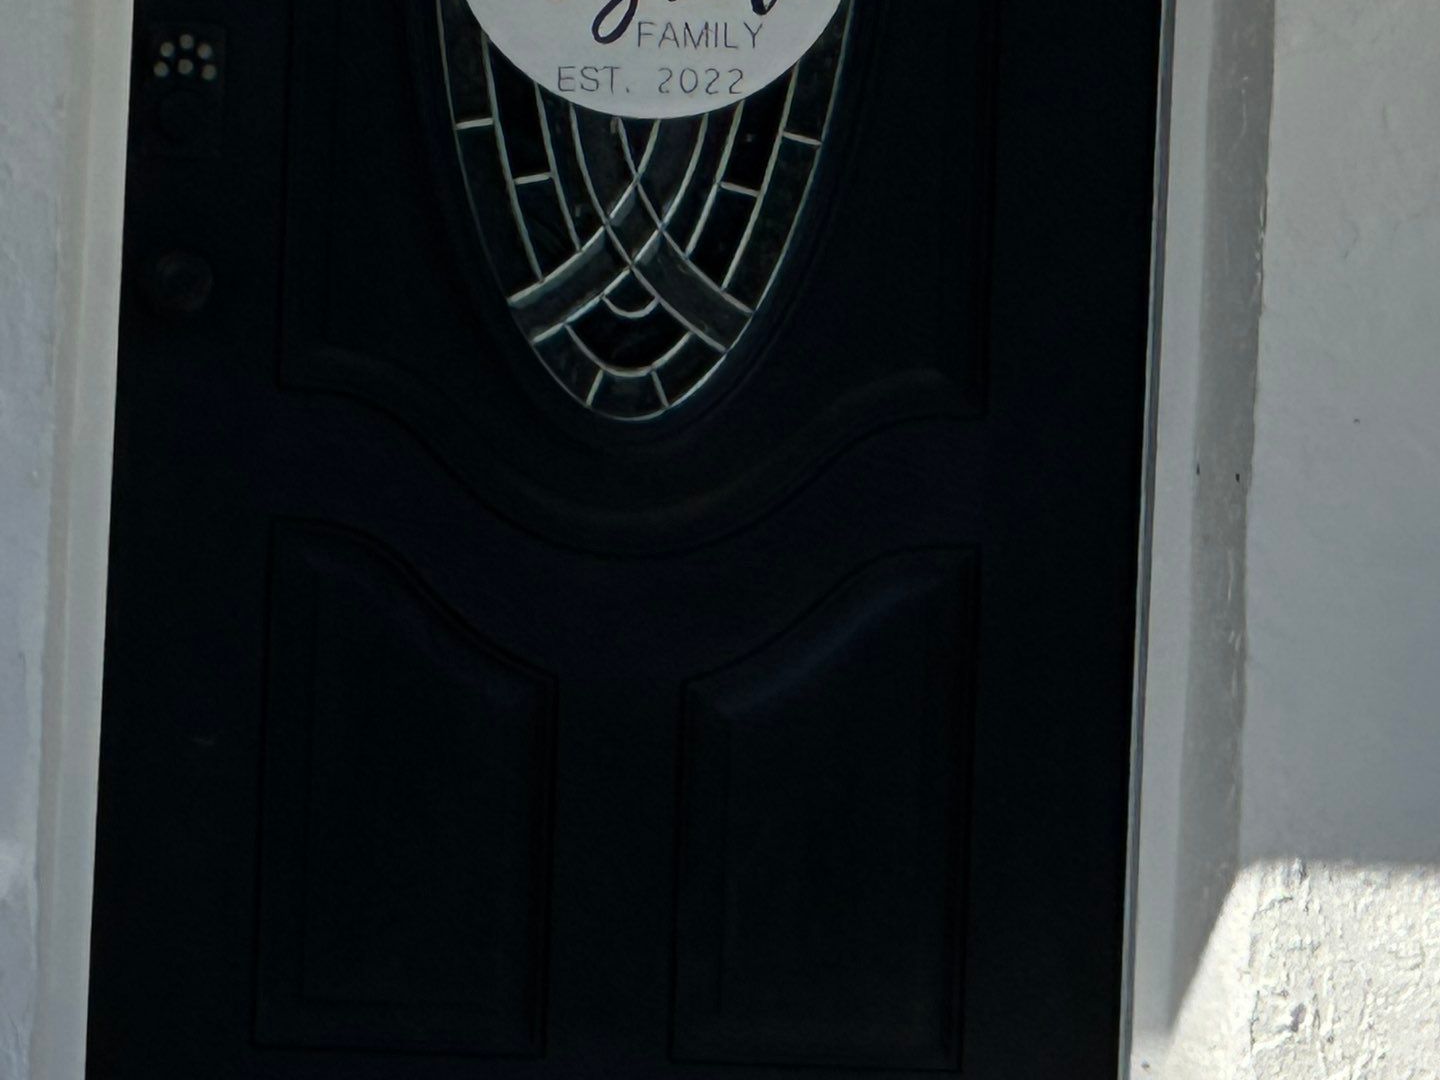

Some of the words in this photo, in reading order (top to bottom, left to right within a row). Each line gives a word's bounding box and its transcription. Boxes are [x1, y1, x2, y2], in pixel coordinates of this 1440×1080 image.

[637, 21, 764, 50] FAMILY
[556, 65, 630, 94] EST.
[657, 67, 745, 95] 2022
